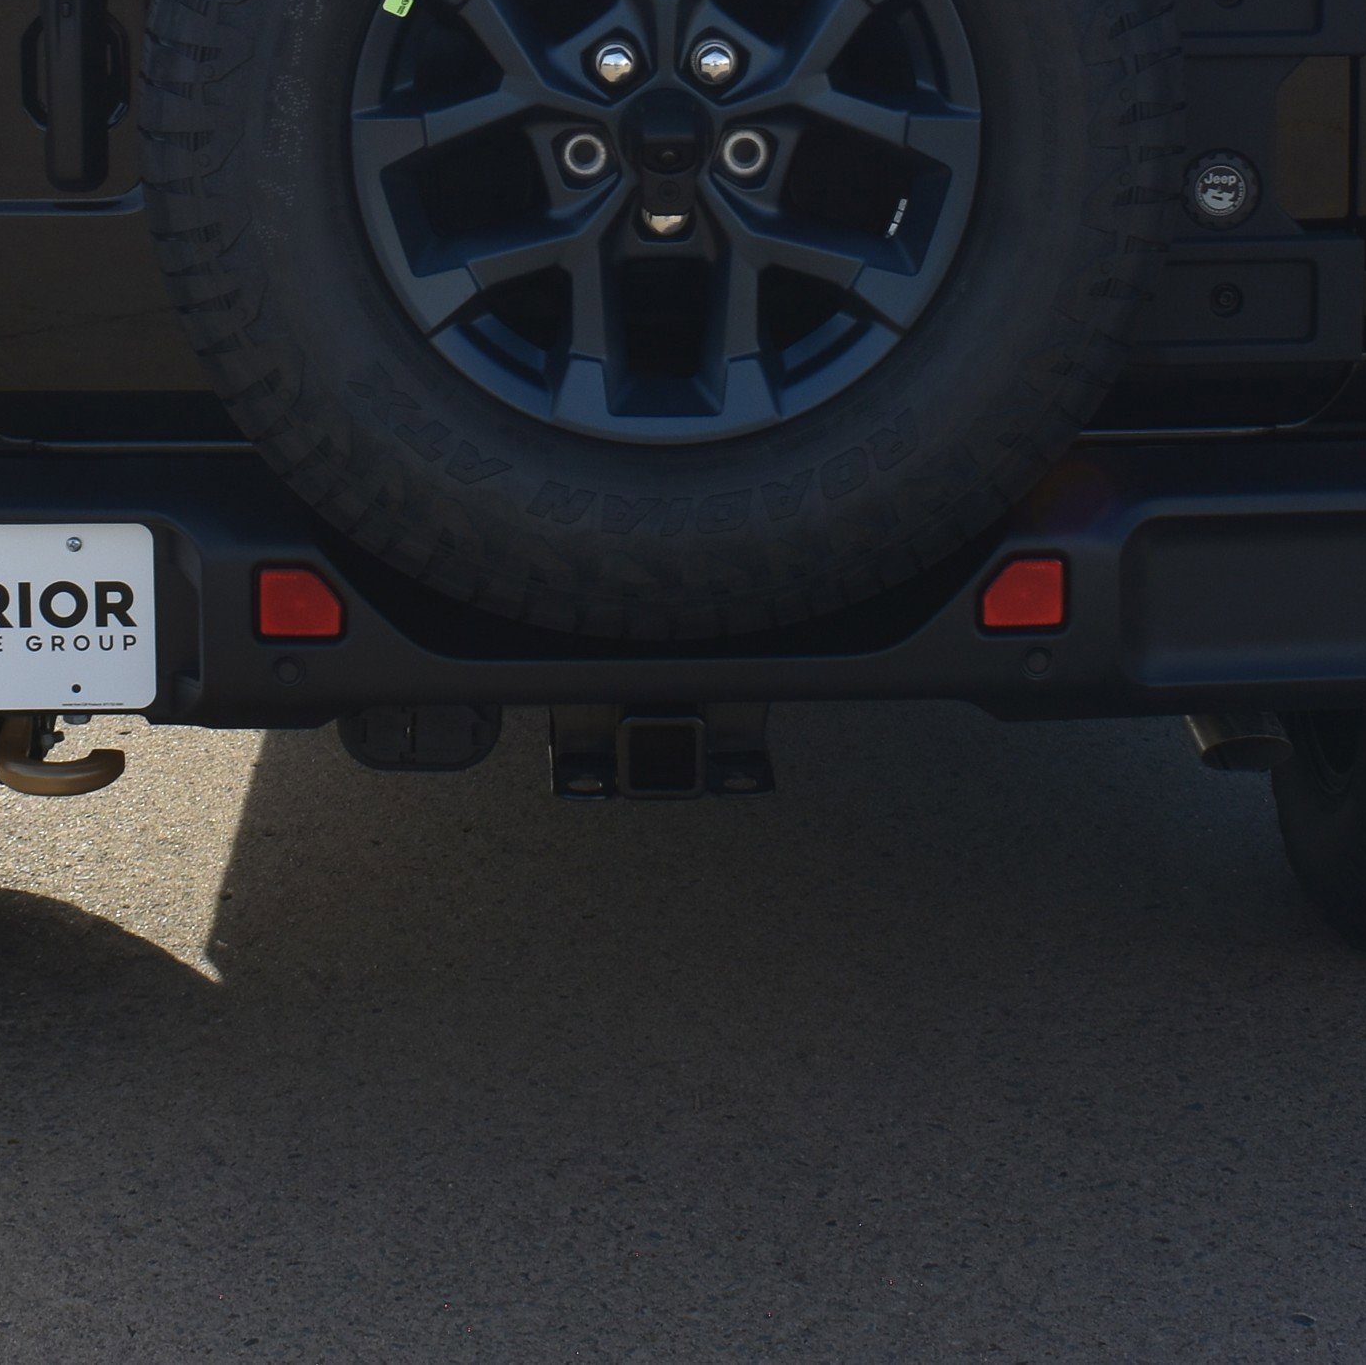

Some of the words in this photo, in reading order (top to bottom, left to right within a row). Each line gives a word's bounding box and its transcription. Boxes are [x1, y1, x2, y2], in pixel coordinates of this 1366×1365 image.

[1203, 173, 1237, 186] Jeep
[525, 407, 919, 538] ROADIAN
[26, 634, 137, 652] GROUP
